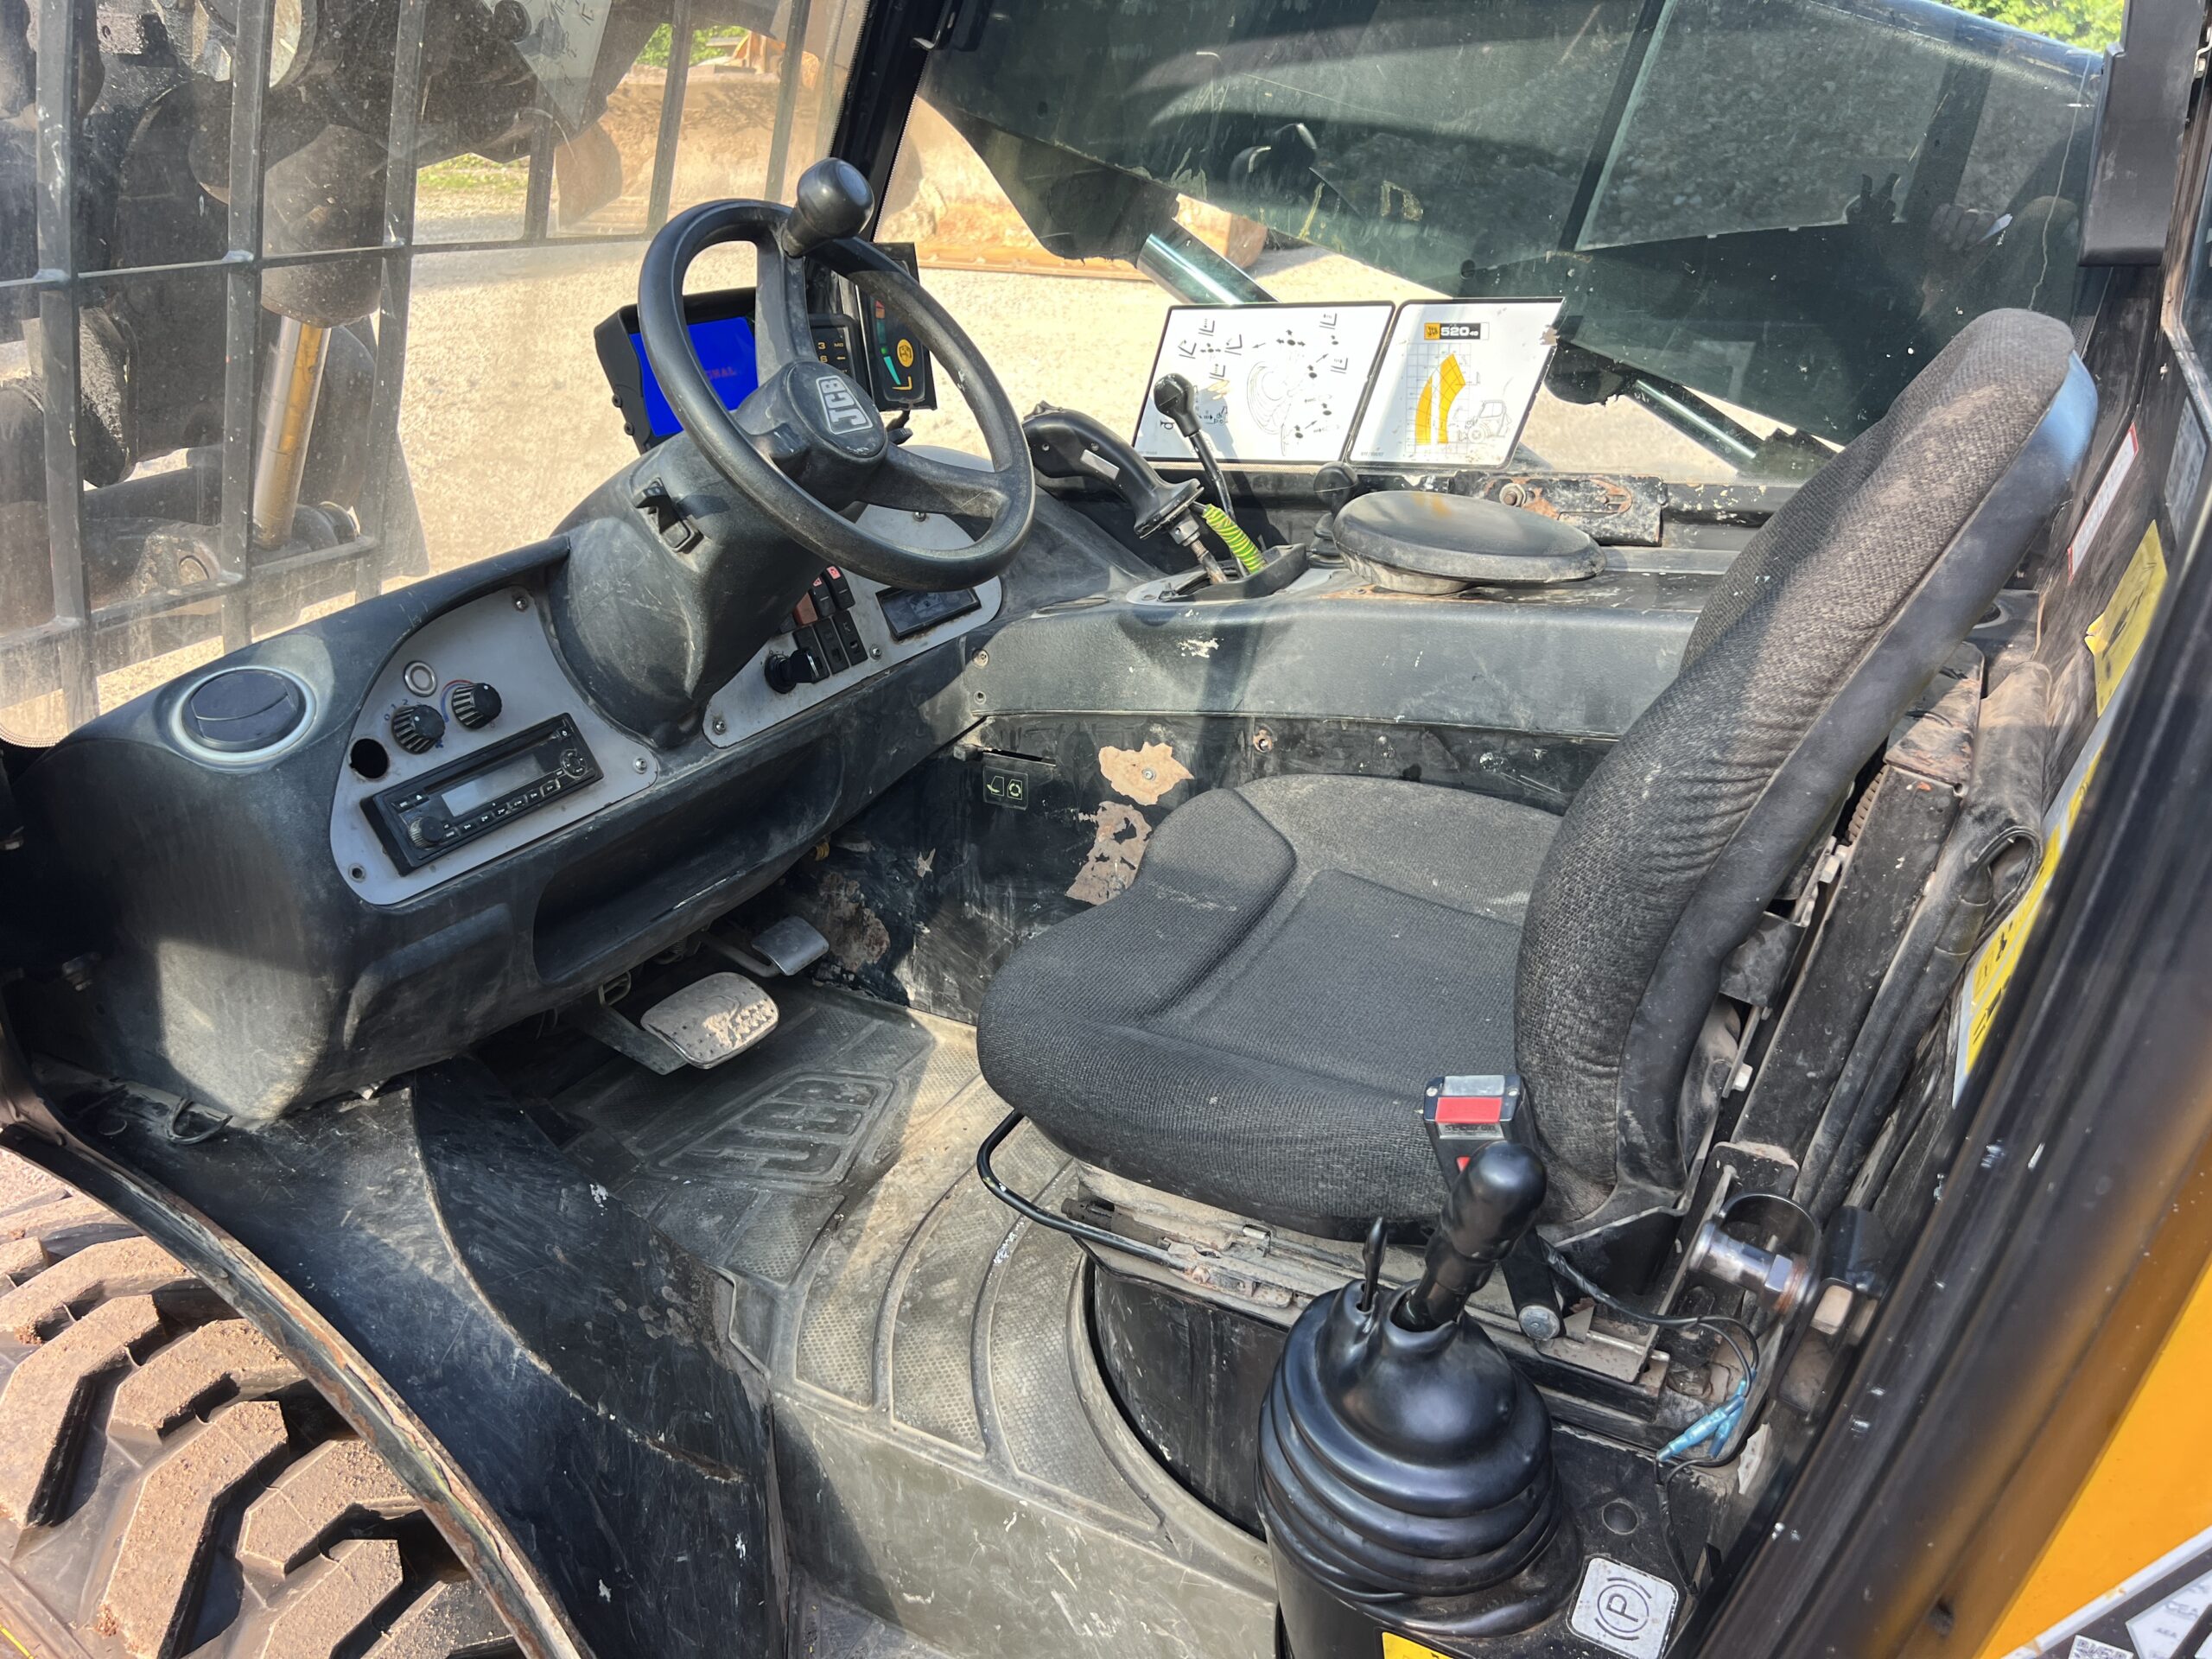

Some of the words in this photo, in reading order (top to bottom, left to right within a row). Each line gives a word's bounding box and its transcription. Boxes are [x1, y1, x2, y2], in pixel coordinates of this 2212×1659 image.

[1440, 327, 1470, 336] 520
[817, 341, 826, 350] 3
[820, 380, 867, 425] JCB
[1606, 1592, 1639, 1623] P
